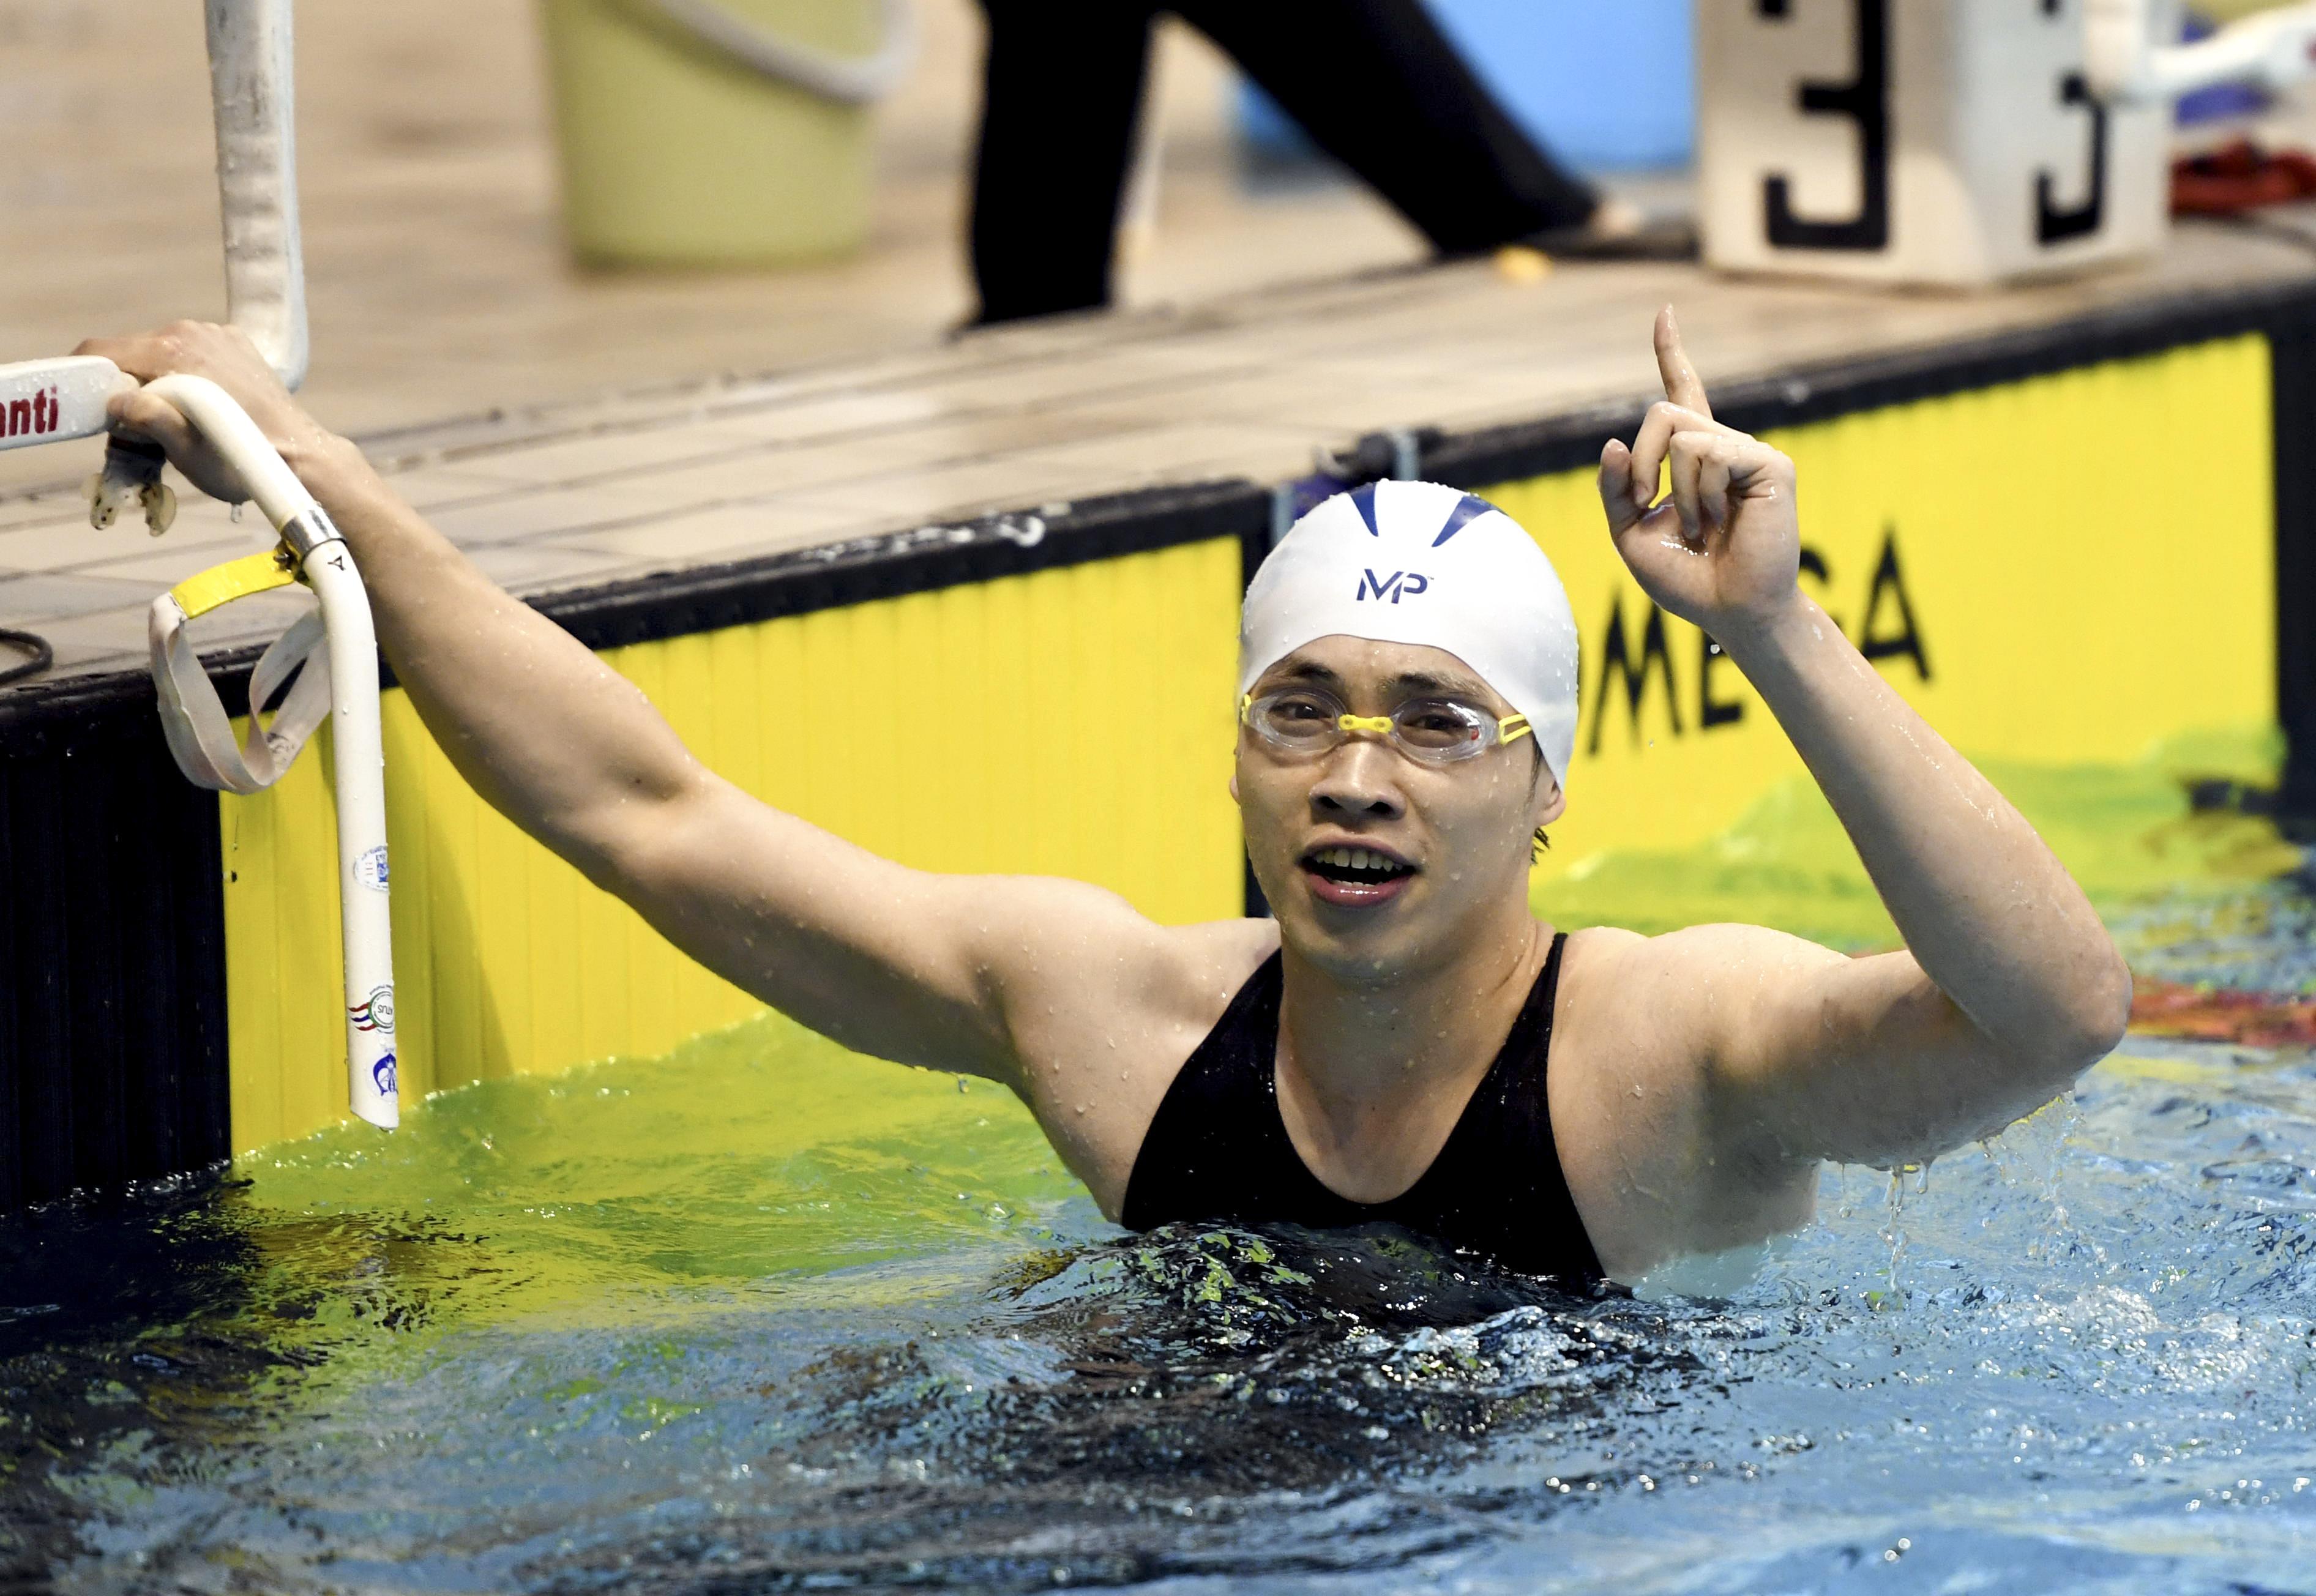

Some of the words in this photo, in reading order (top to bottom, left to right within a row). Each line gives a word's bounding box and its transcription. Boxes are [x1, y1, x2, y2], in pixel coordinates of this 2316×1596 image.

[1760, 0, 1892, 251] 3
[0, 384, 59, 438] nti
[1356, 569, 1428, 605] MP
